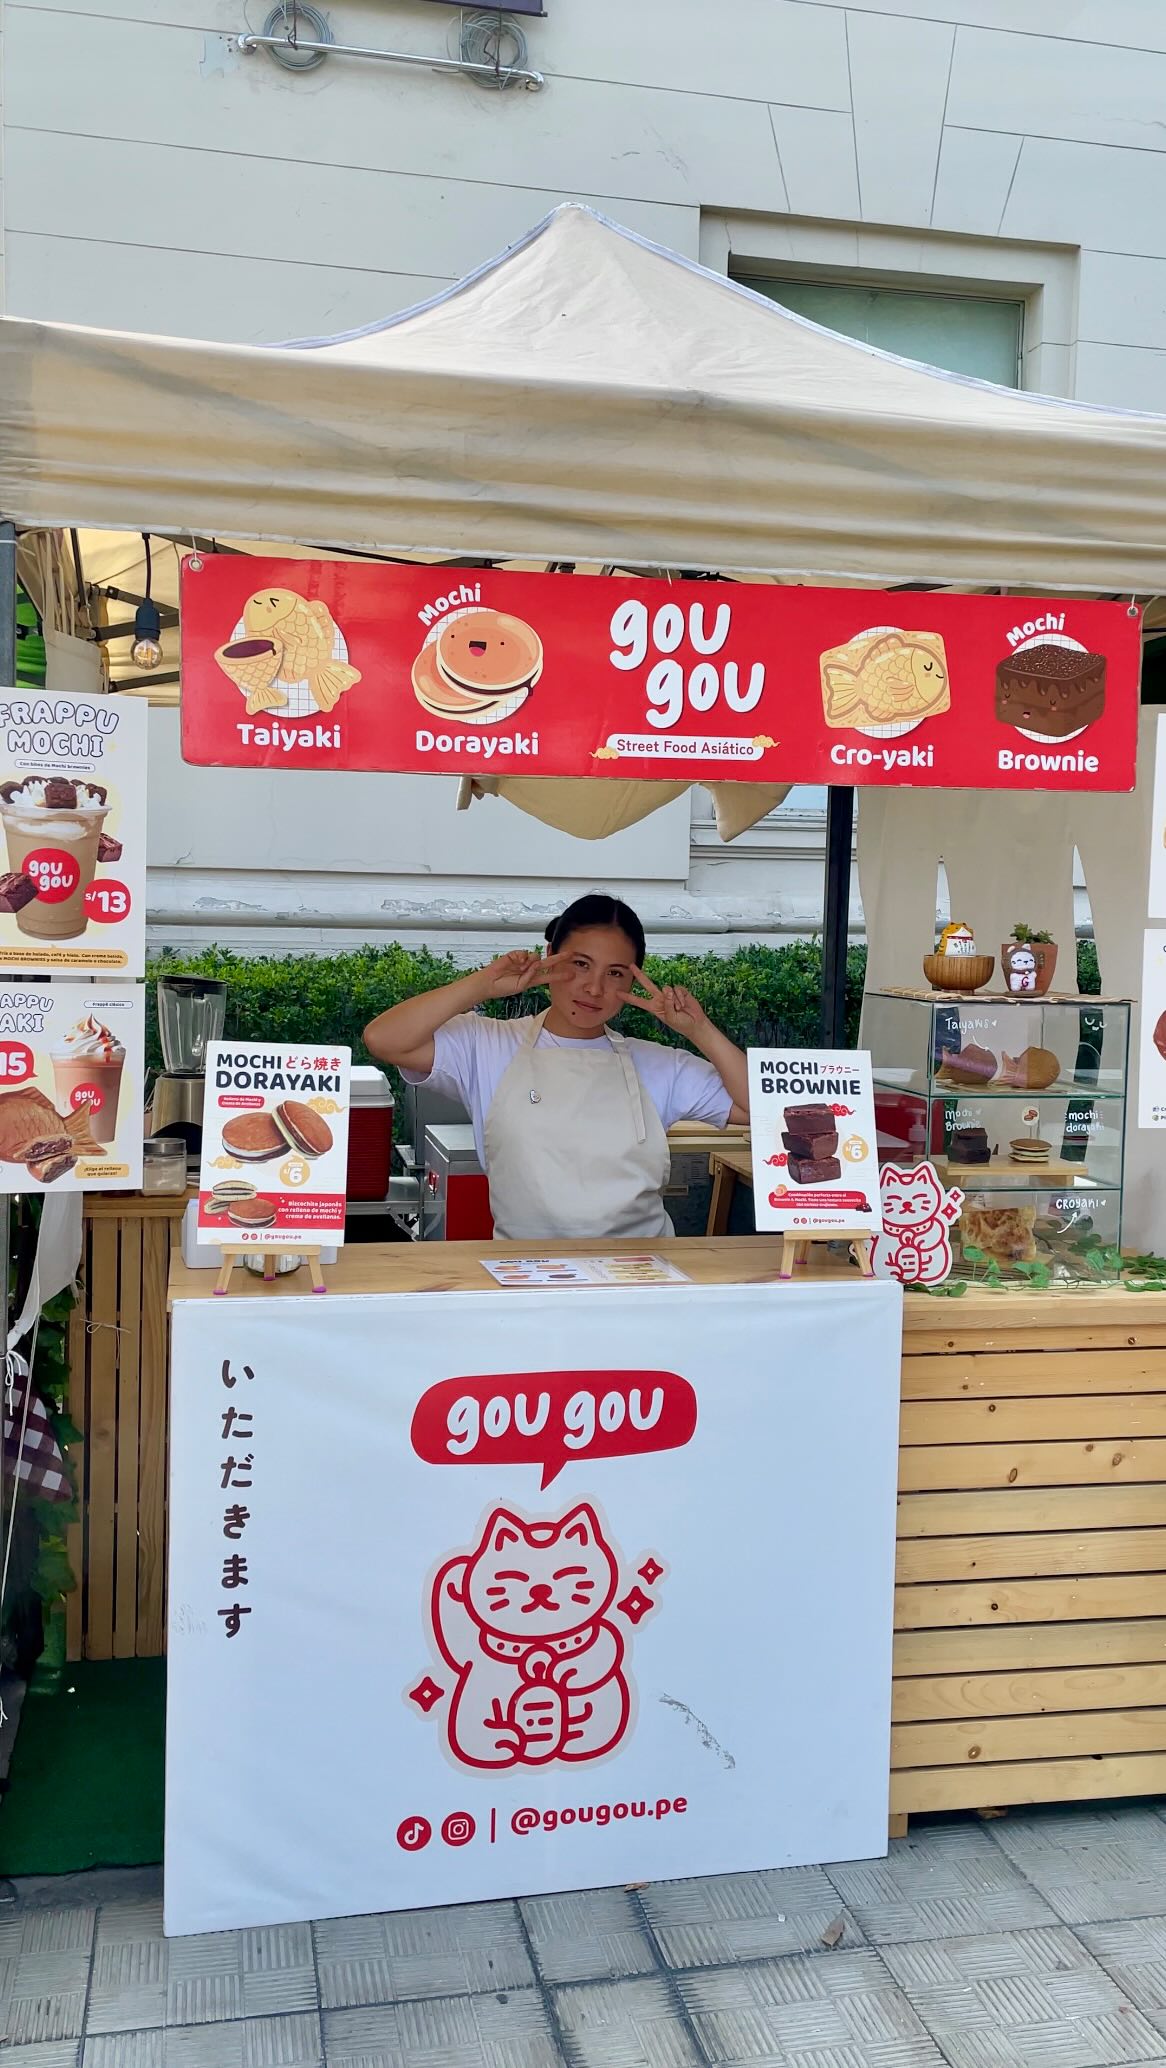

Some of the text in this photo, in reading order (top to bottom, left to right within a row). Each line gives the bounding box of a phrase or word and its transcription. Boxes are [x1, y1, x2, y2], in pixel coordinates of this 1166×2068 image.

[417, 582, 481, 626] Mochi
[609, 599, 731, 671] gou
[1006, 613, 1066, 647] Mochi
[646, 658, 766, 728] gou
[0, 700, 119, 734] FRAPPU
[7, 729, 104, 757] MOCHI
[236, 722, 341, 751] Taiyaki
[415, 730, 539, 759] Dorayaki
[617, 739, 754, 755] Street Food Asiático
[830, 744, 934, 771] Cro-yaki
[998, 749, 1099, 773] Brownie
[28, 860, 63, 877] gou
[39, 875, 74, 892] gou
[0, 1013, 44, 1032] AKI
[216, 1053, 341, 1071] MOCHI どら焼き
[760, 1061, 818, 1075] MOCHI
[215, 1070, 340, 1092] DORAYAKI
[761, 1078, 861, 1095] BROWNIE
[1068, 1109, 1099, 1121] mochi
[446, 1387, 664, 1456] gou gou
[217, 1359, 255, 1639] いただきます
[510, 1797, 688, 1835] @gougou.pe
